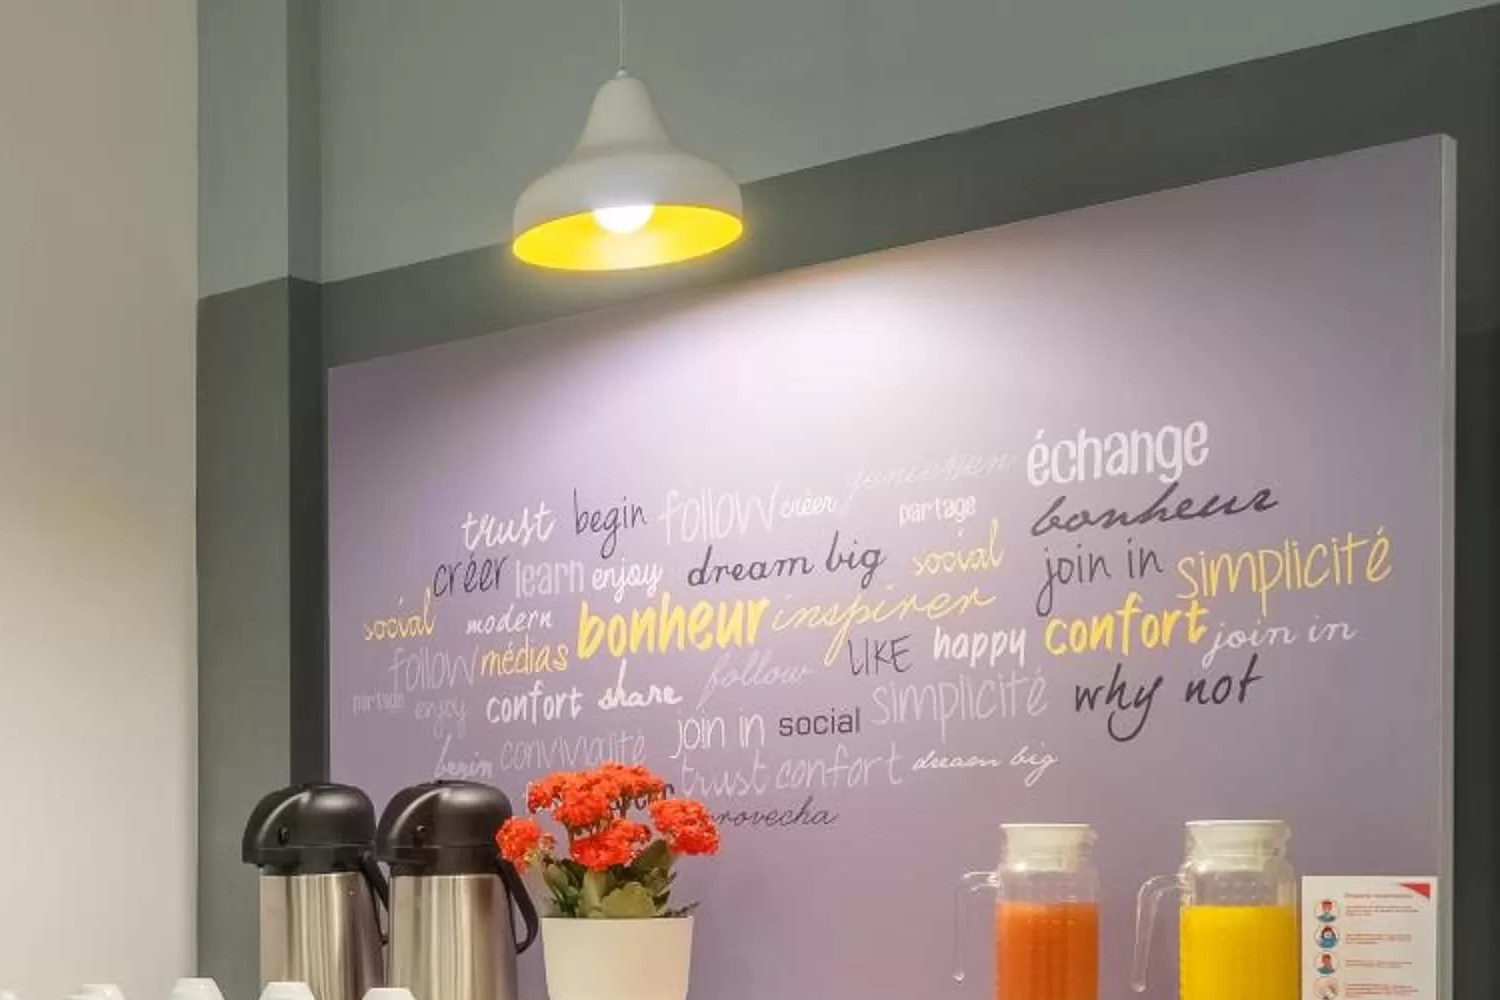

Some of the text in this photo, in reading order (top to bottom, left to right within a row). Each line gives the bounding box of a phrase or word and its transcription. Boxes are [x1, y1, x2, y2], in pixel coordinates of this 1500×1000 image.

[1027, 420, 1209, 486] échange
[460, 500, 558, 551] trust
[572, 486, 648, 560] begin
[659, 482, 779, 545] follow
[899, 495, 977, 528] partage
[1029, 480, 1280, 537] bonheur
[433, 516, 1393, 620] créer learn enjoy dream big social join in simplicité
[362, 586, 438, 641] social
[464, 601, 555, 636] modern
[576, 592, 772, 661] bonheur
[932, 624, 1028, 669] happy
[1044, 590, 1211, 657] confort
[1200, 620, 1299, 670] join
[1307, 613, 1361, 644] in
[387, 644, 480, 695] follow
[479, 634, 569, 677] médias
[870, 665, 1050, 744] simplicité
[1074, 661, 1165, 743] why
[1183, 651, 1266, 704] not
[485, 678, 585, 728] confort
[598, 658, 683, 709] share
[668, 707, 726, 759] join
[738, 707, 767, 750] in
[778, 703, 862, 738] social
[680, 748, 769, 798] trust
[774, 741, 906, 788] confort
[911, 748, 1003, 772] dream
[1008, 741, 1062, 788] big
[708, 794, 841, 829] rovecha
